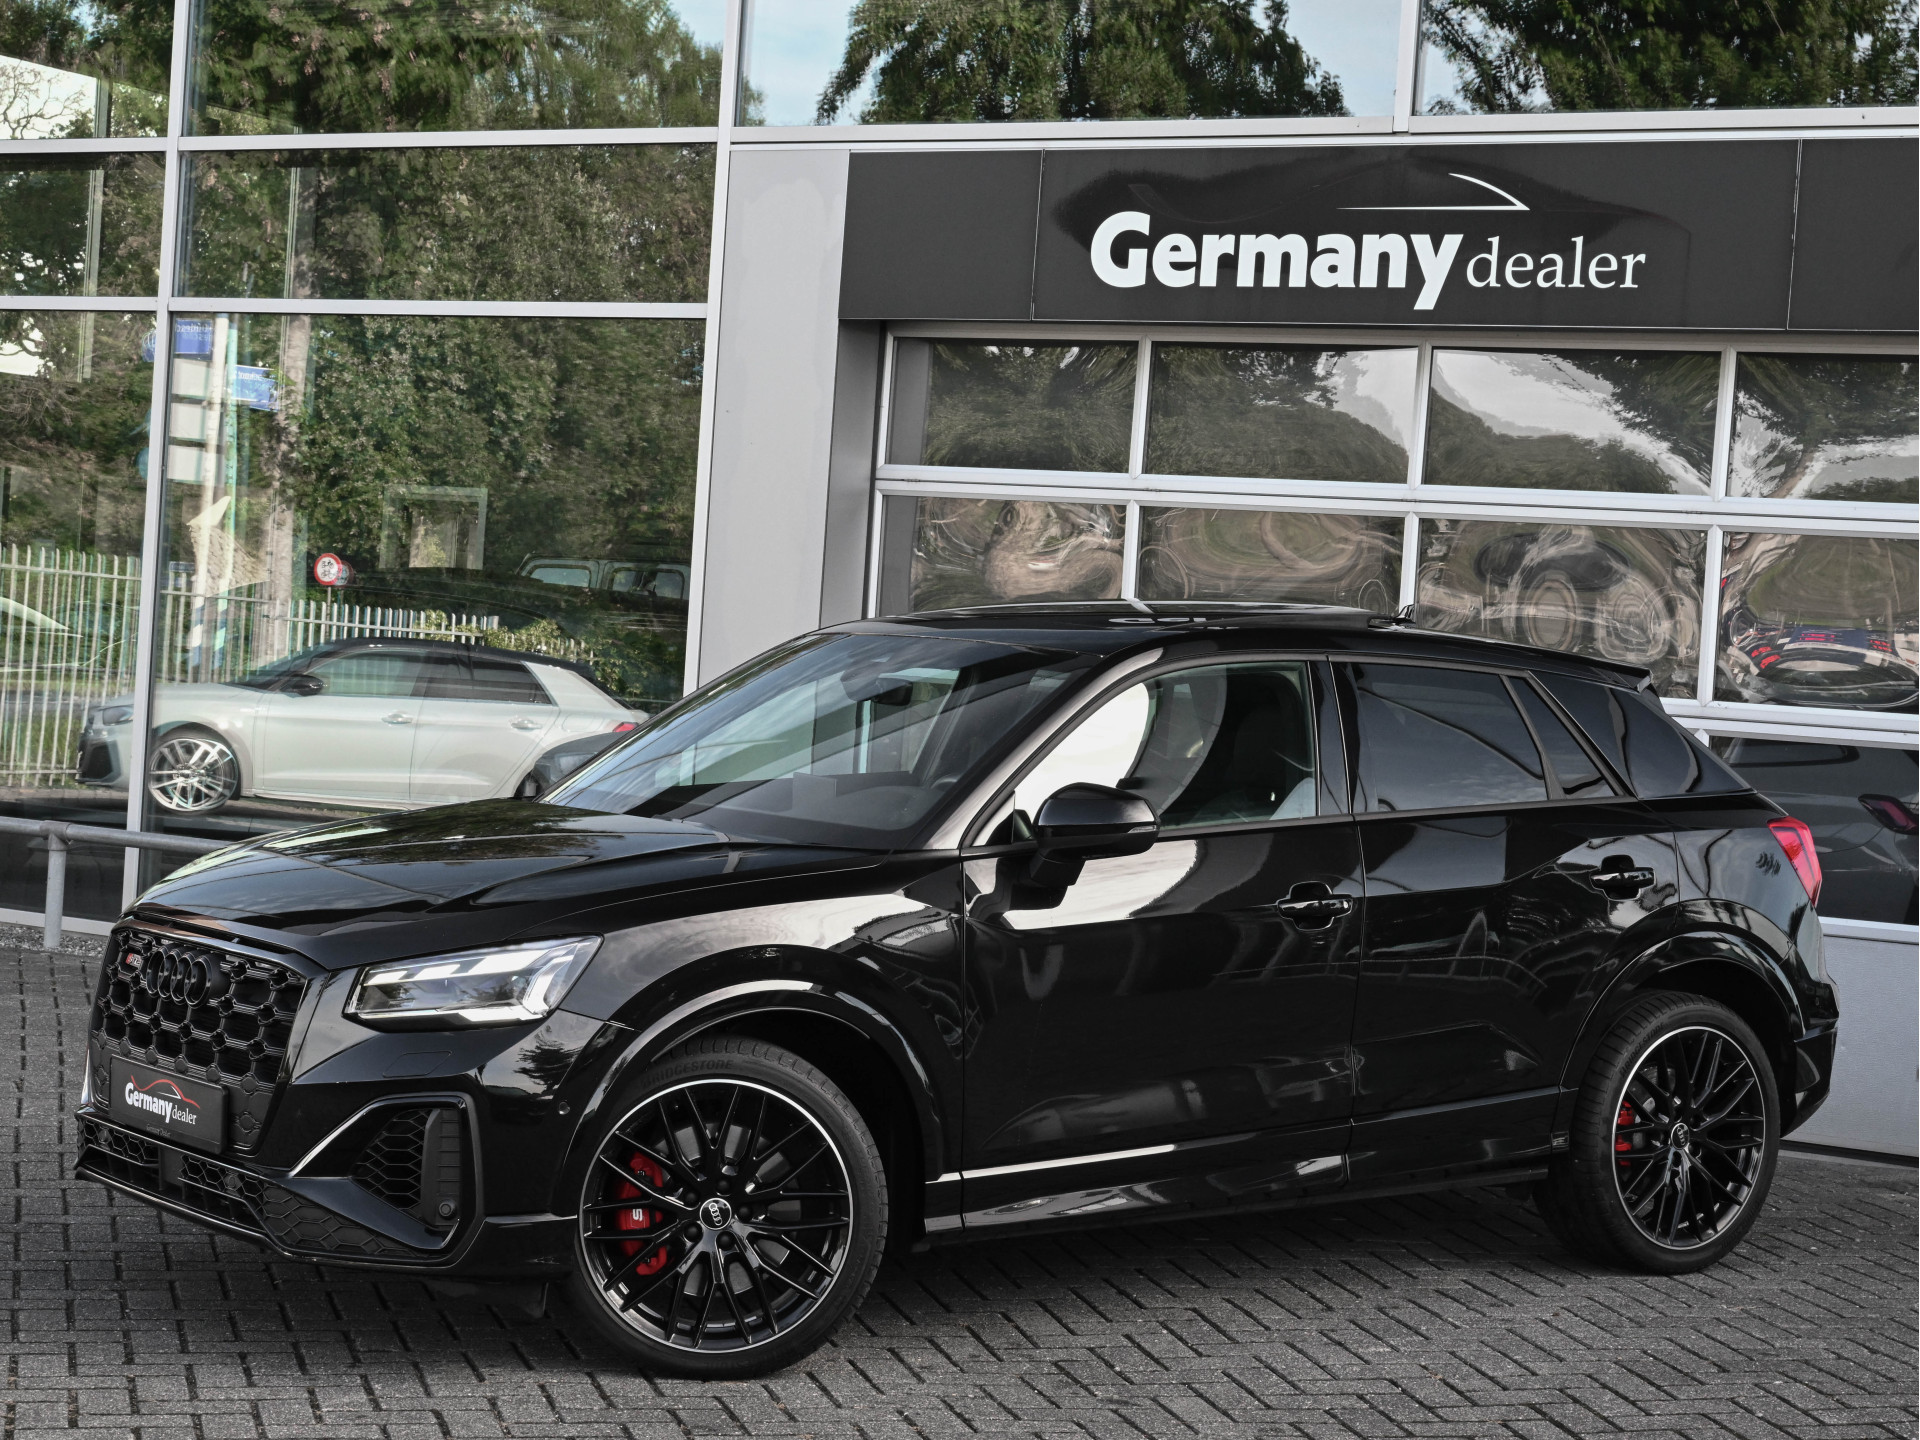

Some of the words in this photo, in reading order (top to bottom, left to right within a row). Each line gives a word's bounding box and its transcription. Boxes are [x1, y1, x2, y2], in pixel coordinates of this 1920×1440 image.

[1090, 211, 1464, 310] Germany
[1466, 236, 1646, 289] dealer
[641, 1059, 734, 1088] BRIDGESTONE
[125, 1082, 173, 1123] Germany
[172, 1104, 197, 1125] dealer
